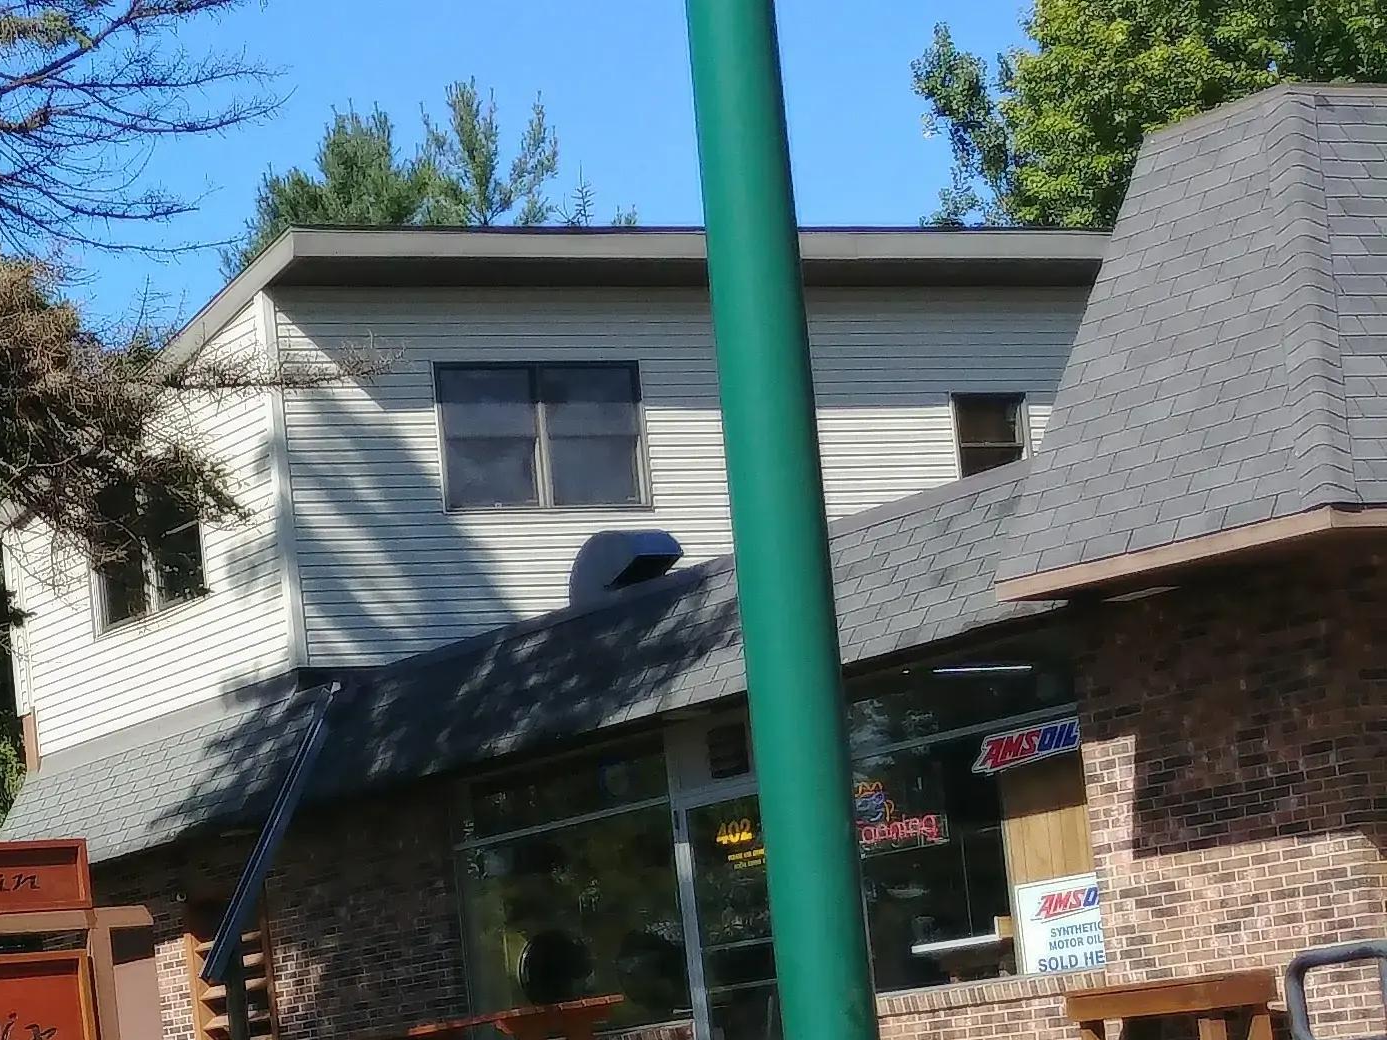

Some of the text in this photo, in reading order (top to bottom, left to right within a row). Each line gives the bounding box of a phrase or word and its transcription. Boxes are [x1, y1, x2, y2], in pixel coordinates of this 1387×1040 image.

[978, 721, 1080, 769] AMSOIL
[1049, 933, 1104, 951] MOTOR OIL
[1038, 954, 1079, 973] SOLD
